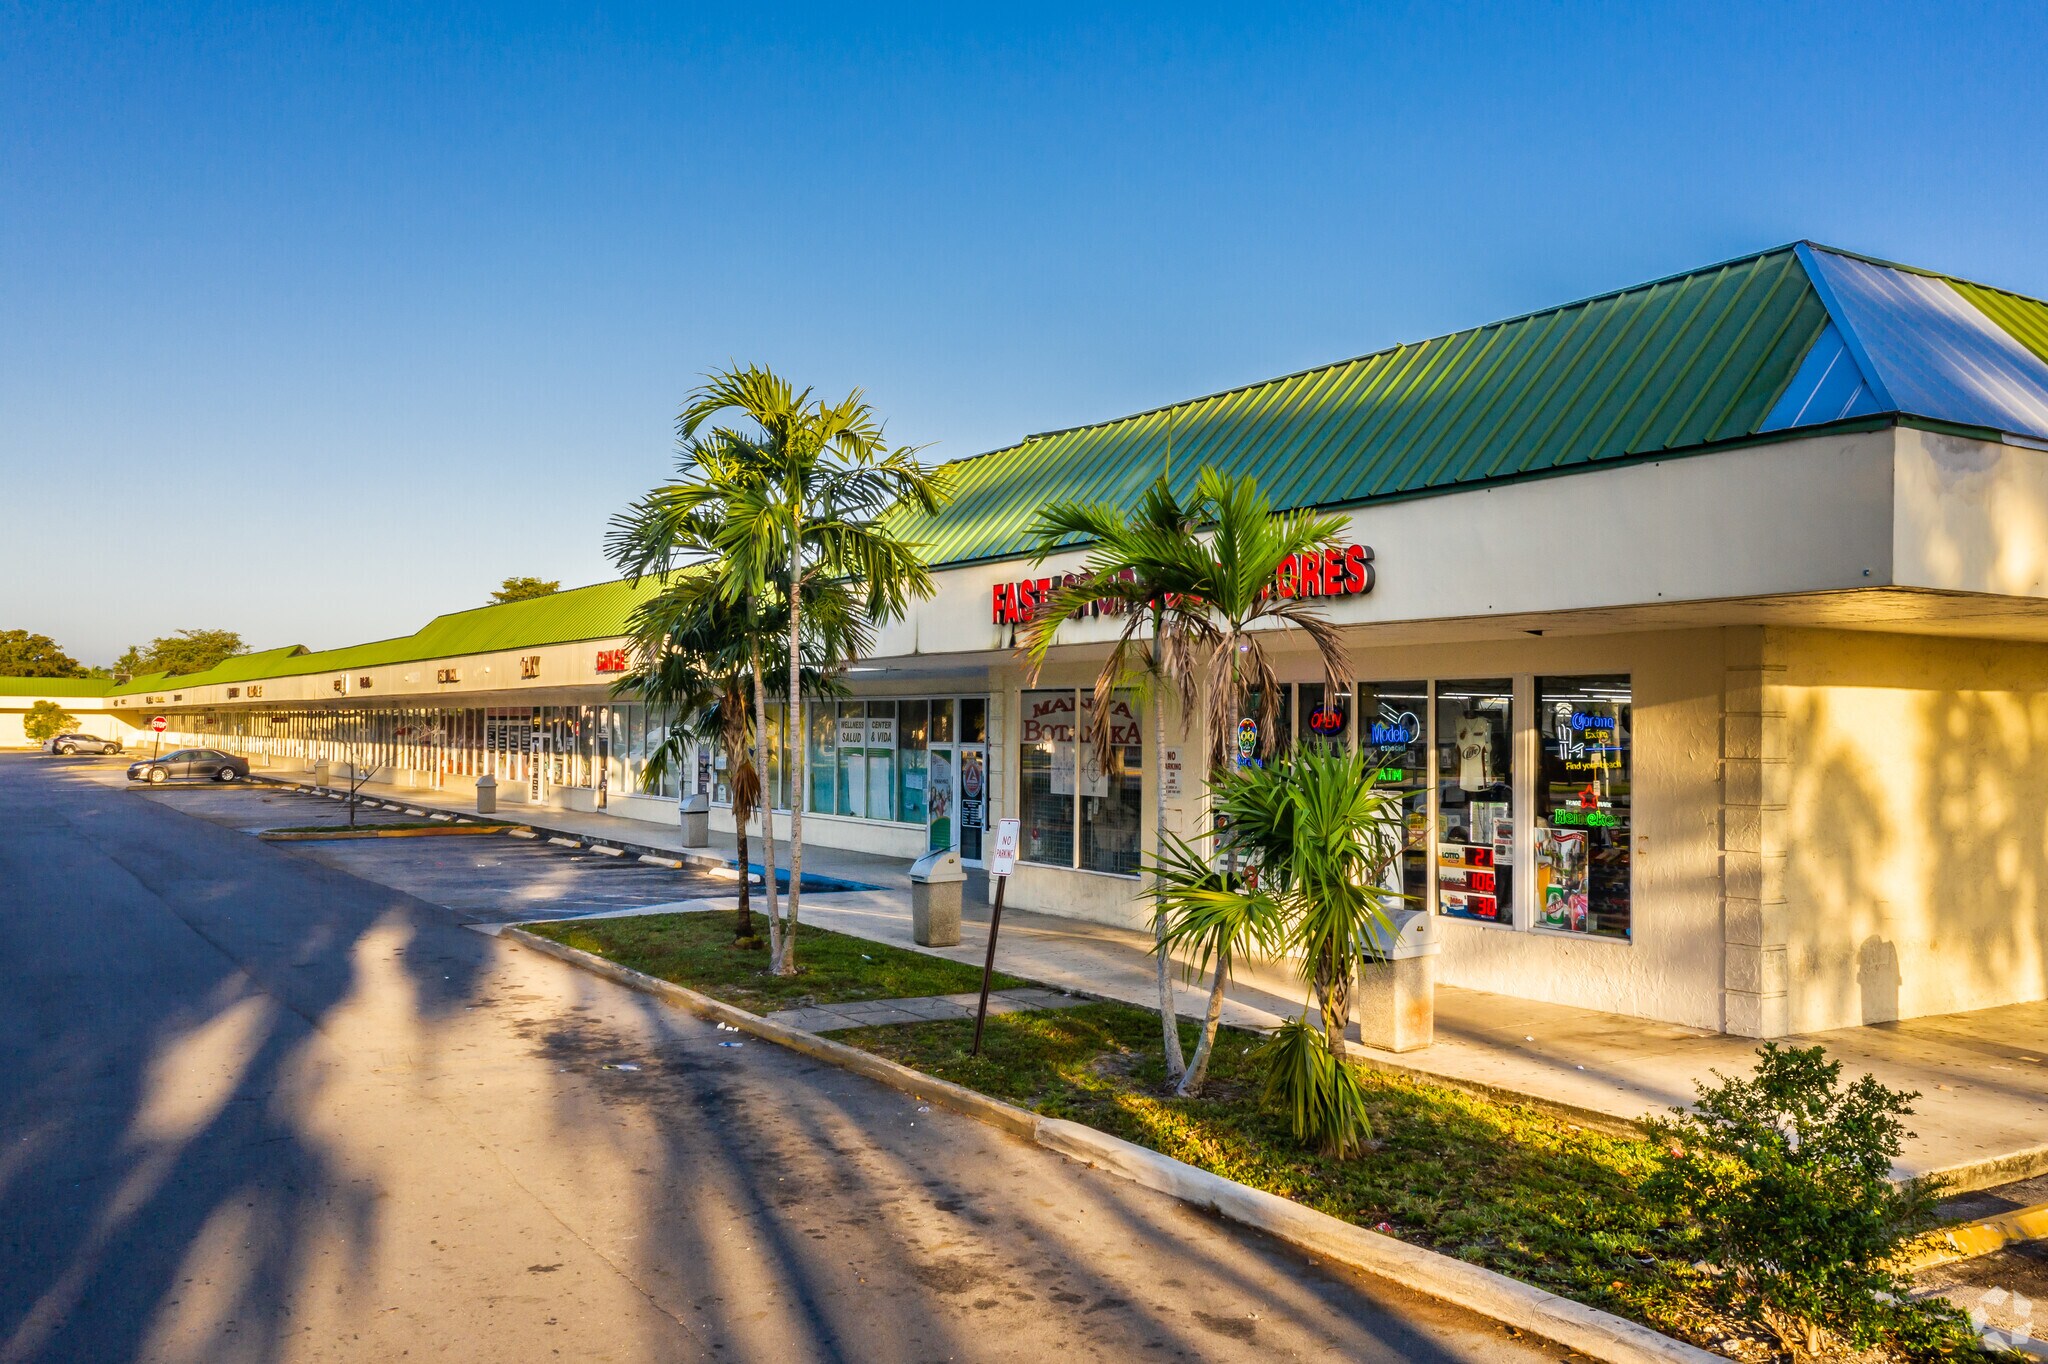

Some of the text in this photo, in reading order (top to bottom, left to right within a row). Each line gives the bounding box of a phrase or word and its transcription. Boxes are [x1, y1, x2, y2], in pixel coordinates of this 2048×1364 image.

[992, 578, 1051, 624] FAST
[841, 720, 892, 729] WELLNESS CENTER
[1311, 712, 1342, 729] OPEN
[1572, 711, 1615, 731] Corona
[842, 731, 892, 743] SALUD & VIDA
[1372, 722, 1409, 744] Modelo
[1585, 728, 1609, 740] Extra
[1380, 744, 1406, 752] especial
[1167, 751, 1176, 761] NO
[1566, 761, 1581, 771] Find
[1600, 760, 1622, 770] beach
[1378, 767, 1402, 781] ATM
[1554, 808, 1622, 827] Heineken
[1002, 835, 1011, 846] NO
[1441, 851, 1460, 860] LOTTO
[1471, 872, 1495, 892] 106
[1478, 896, 1496, 916] 30
